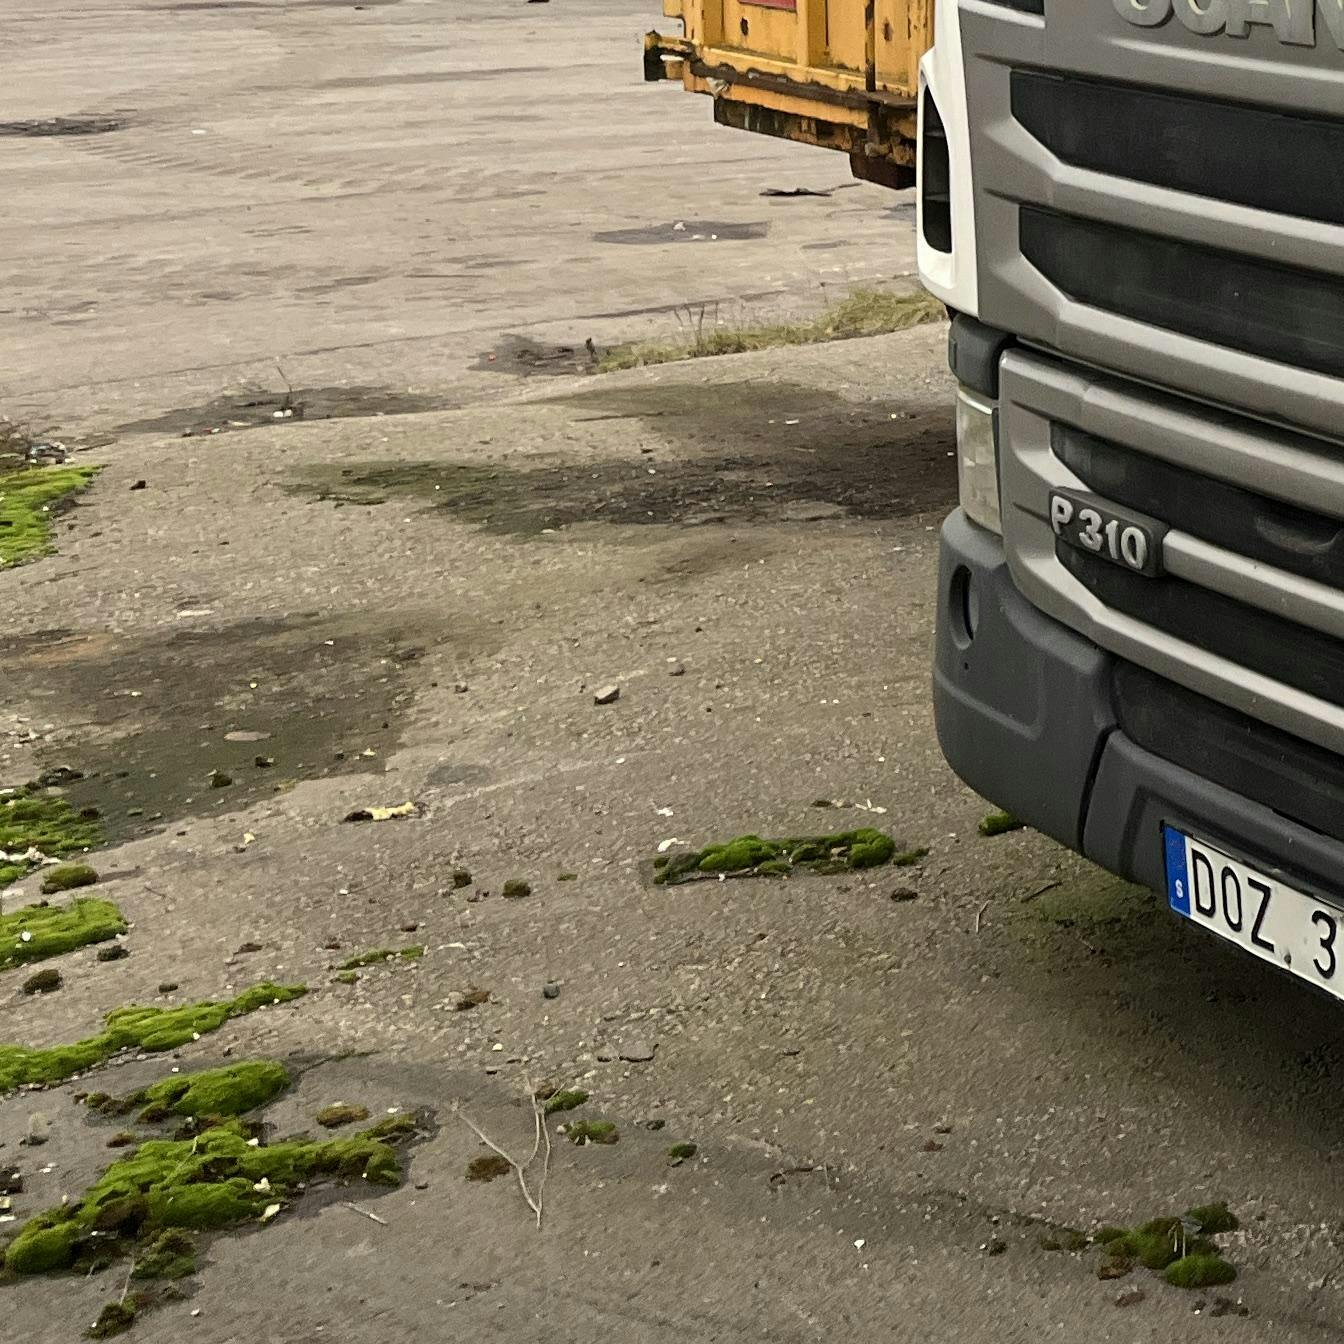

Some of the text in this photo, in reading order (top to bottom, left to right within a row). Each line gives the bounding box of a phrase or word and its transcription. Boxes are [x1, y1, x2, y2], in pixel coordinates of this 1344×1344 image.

[1050, 494, 1149, 571] P 310
[1175, 879, 1184, 899] S
[1192, 848, 1275, 953] DOZ
